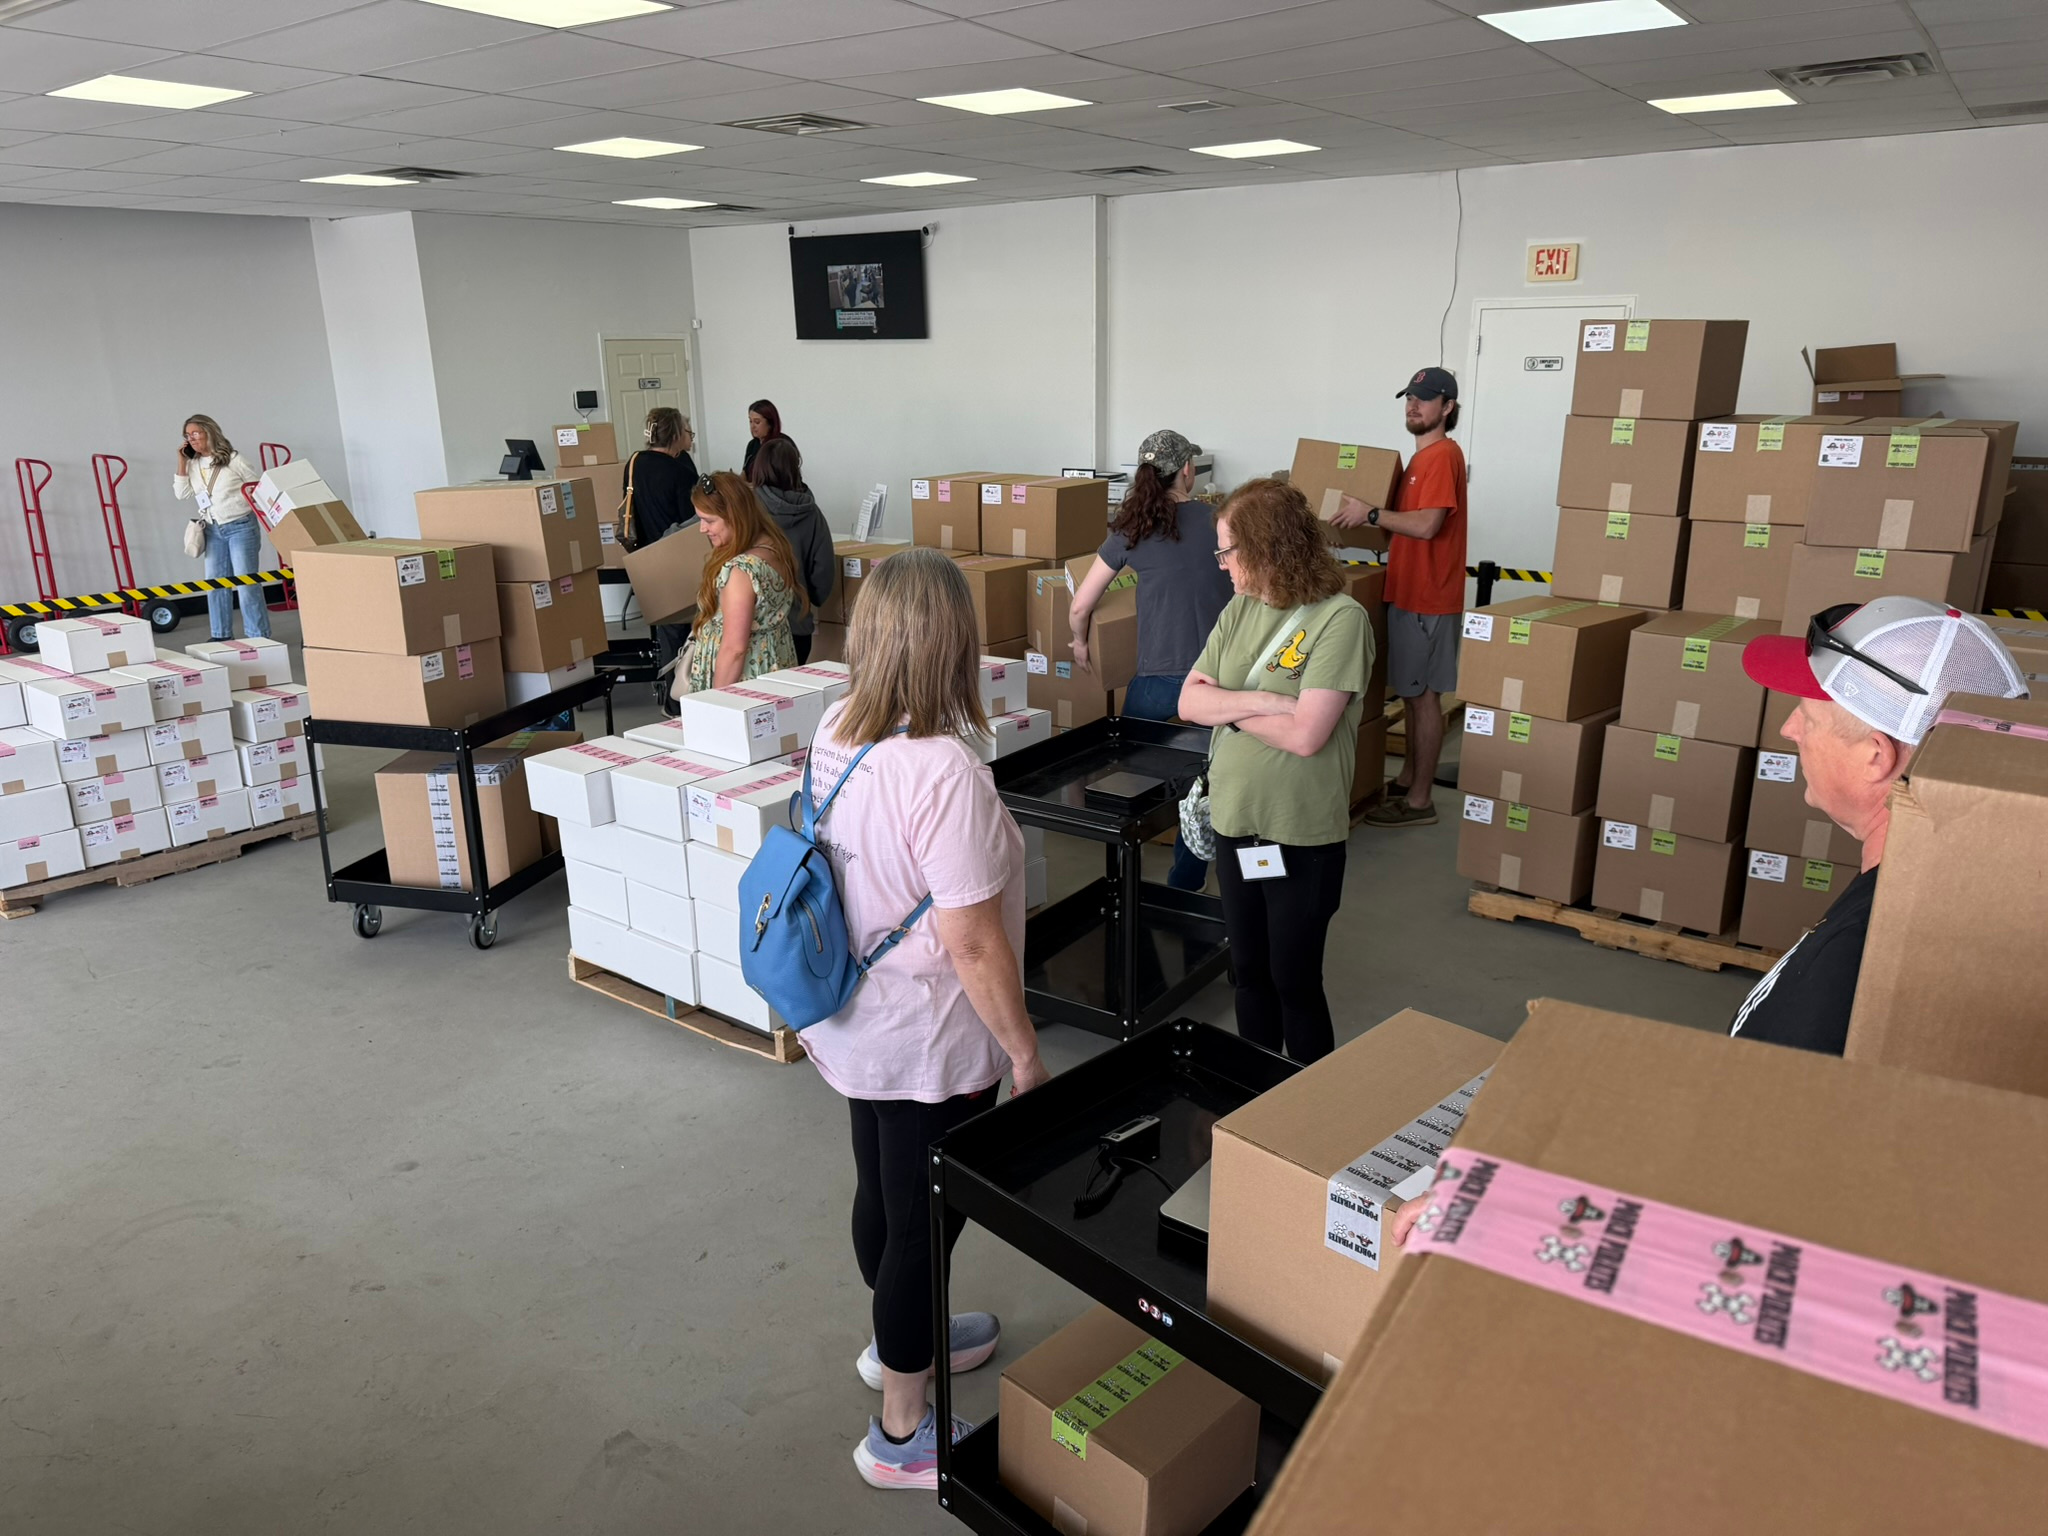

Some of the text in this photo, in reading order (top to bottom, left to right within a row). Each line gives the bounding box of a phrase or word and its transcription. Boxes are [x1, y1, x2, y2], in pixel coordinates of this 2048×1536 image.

[1535, 248, 1571, 275] EXIT
[814, 746, 836, 759] person
[859, 761, 874, 775] me,
[1393, 1134, 1421, 1148] PIRATES
[1370, 1150, 1398, 1165] PIRATES
[1346, 1167, 1374, 1184] PIRATES
[1330, 1193, 1379, 1221] PORCH PIRATES
[1328, 1231, 1377, 1261] PORCH PIRATES
